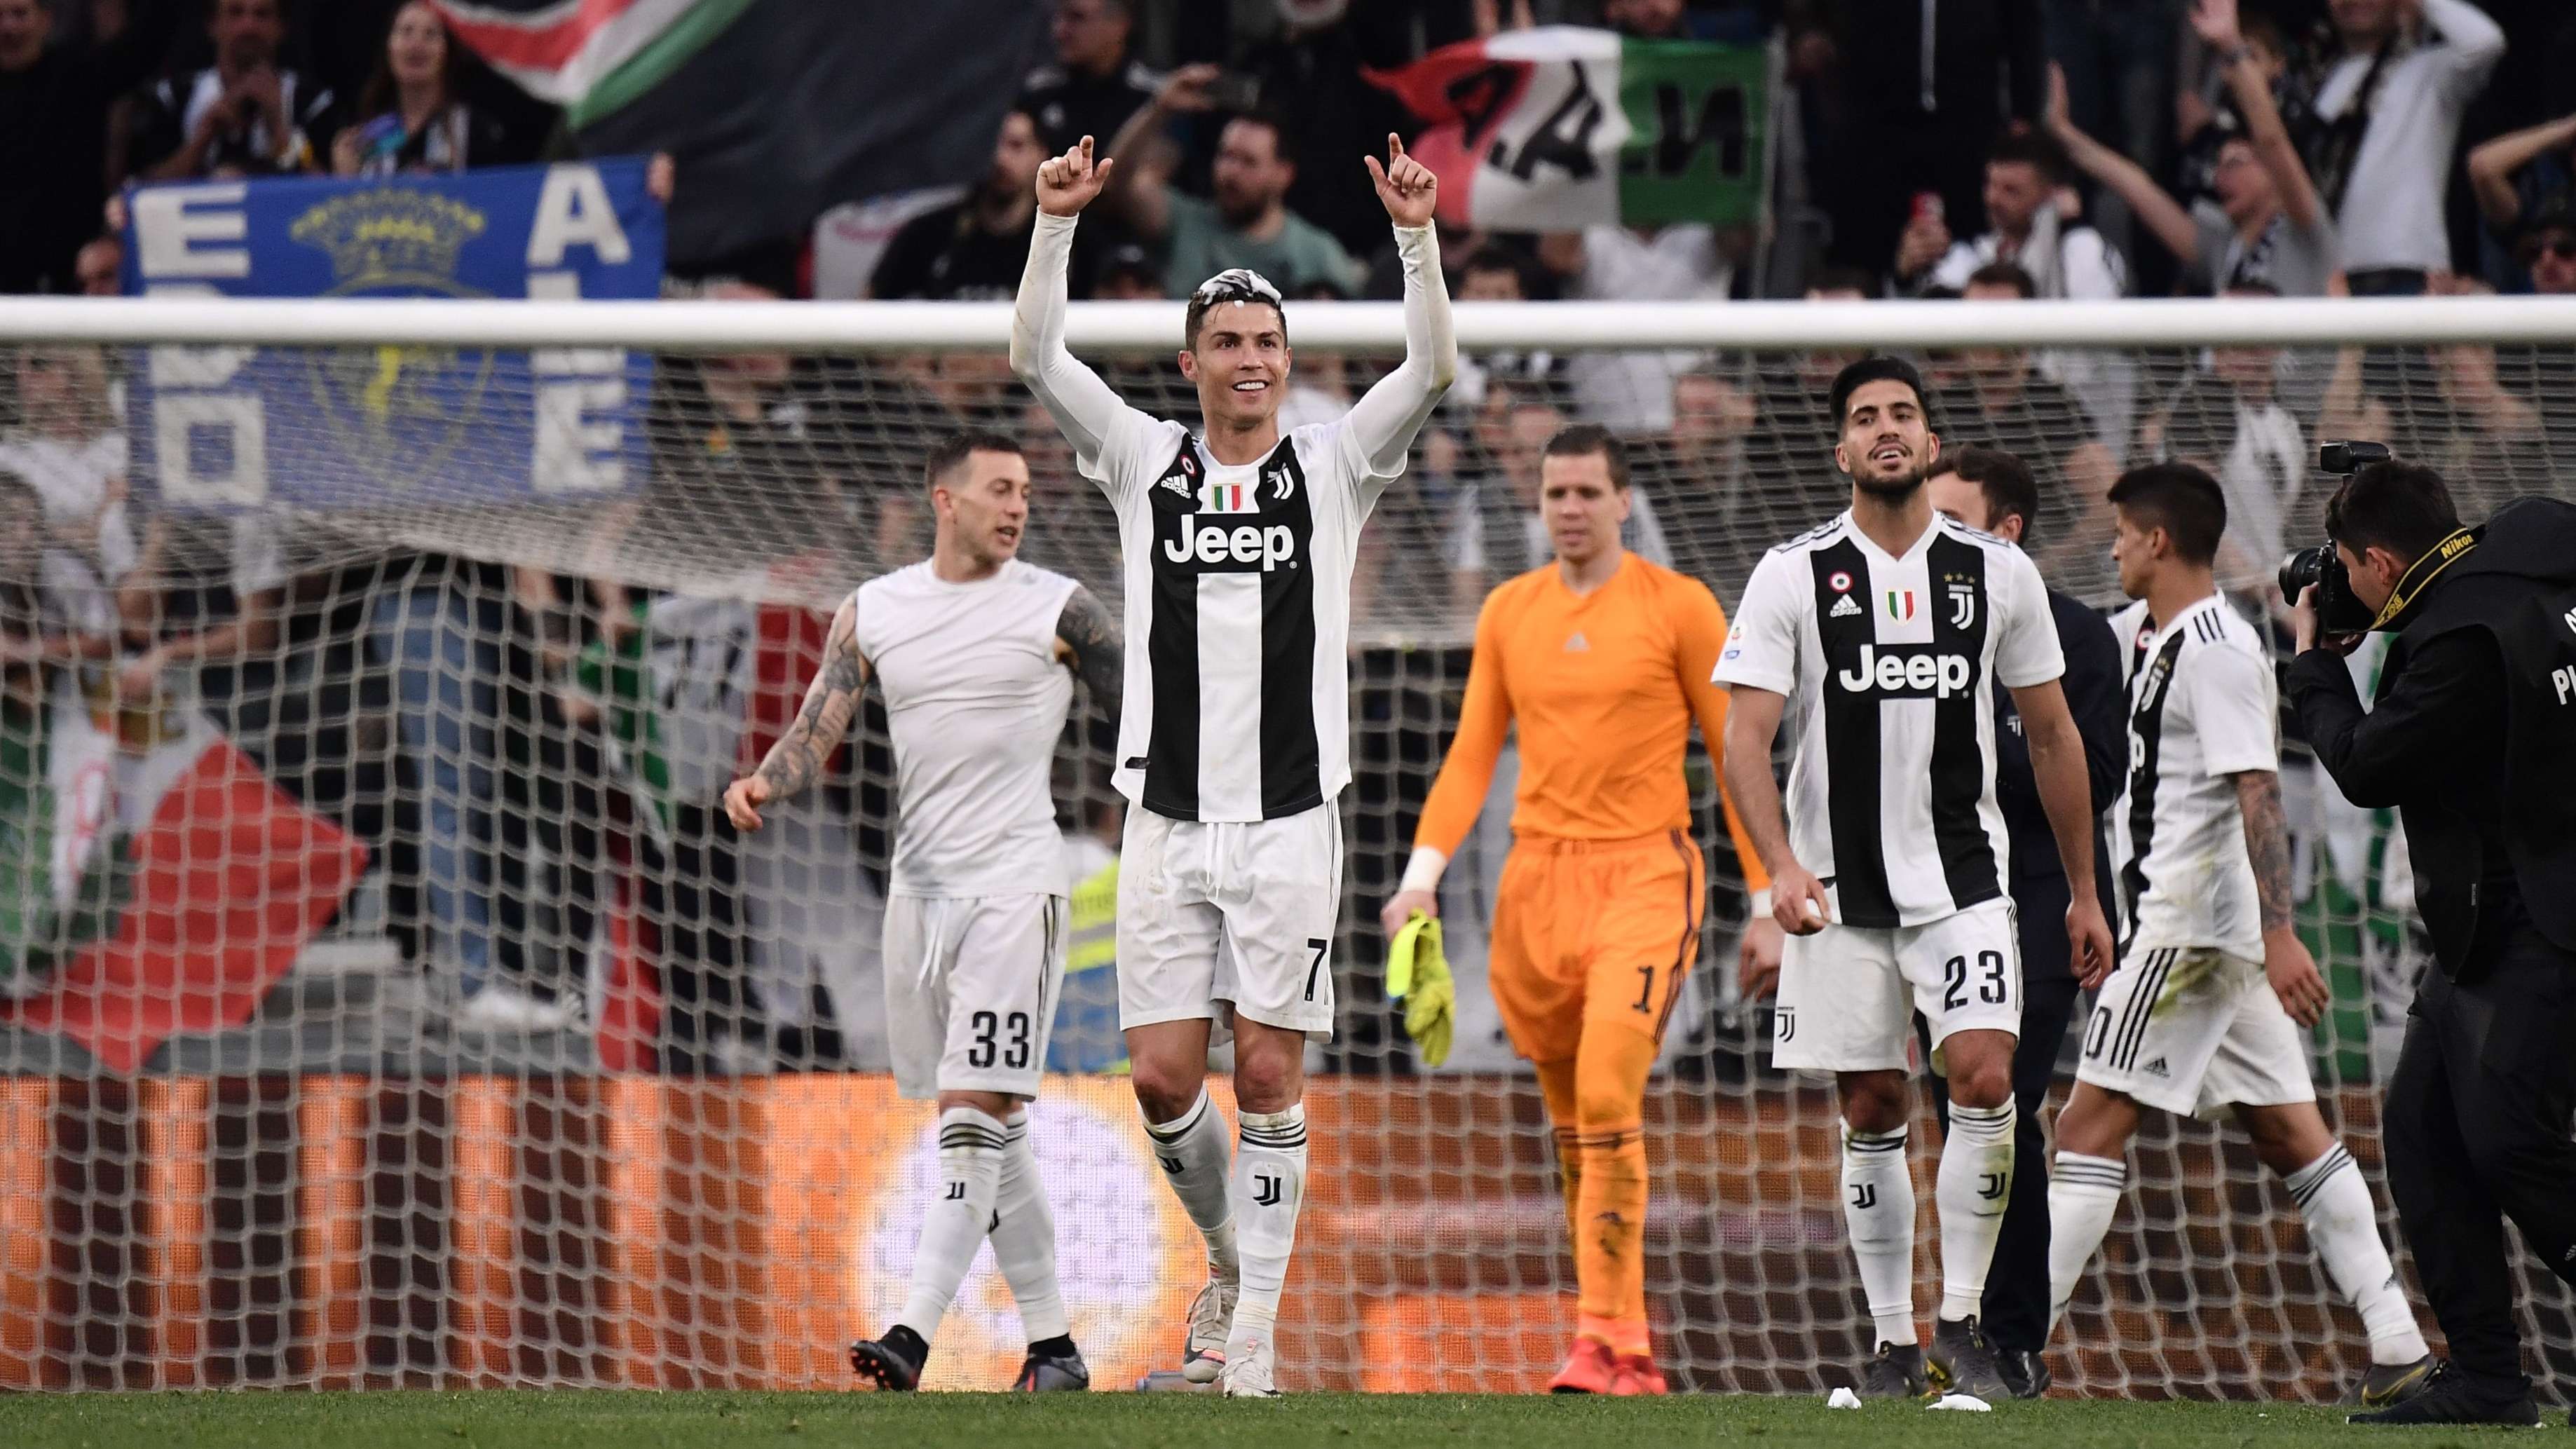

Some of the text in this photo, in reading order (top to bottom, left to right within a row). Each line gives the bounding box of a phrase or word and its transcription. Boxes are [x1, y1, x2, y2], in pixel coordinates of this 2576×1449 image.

[1160, 479, 1192, 498] adidas
[1164, 514, 1295, 572] Jeep
[2440, 534, 2474, 559] Nikon
[1829, 606, 1862, 618] adidas
[1839, 644, 1970, 699] Jeep
[1304, 937, 1328, 1002] 7
[1632, 965, 1654, 1014] 1
[1944, 949, 2007, 1013] 23
[969, 1012, 1030, 1069] 33
